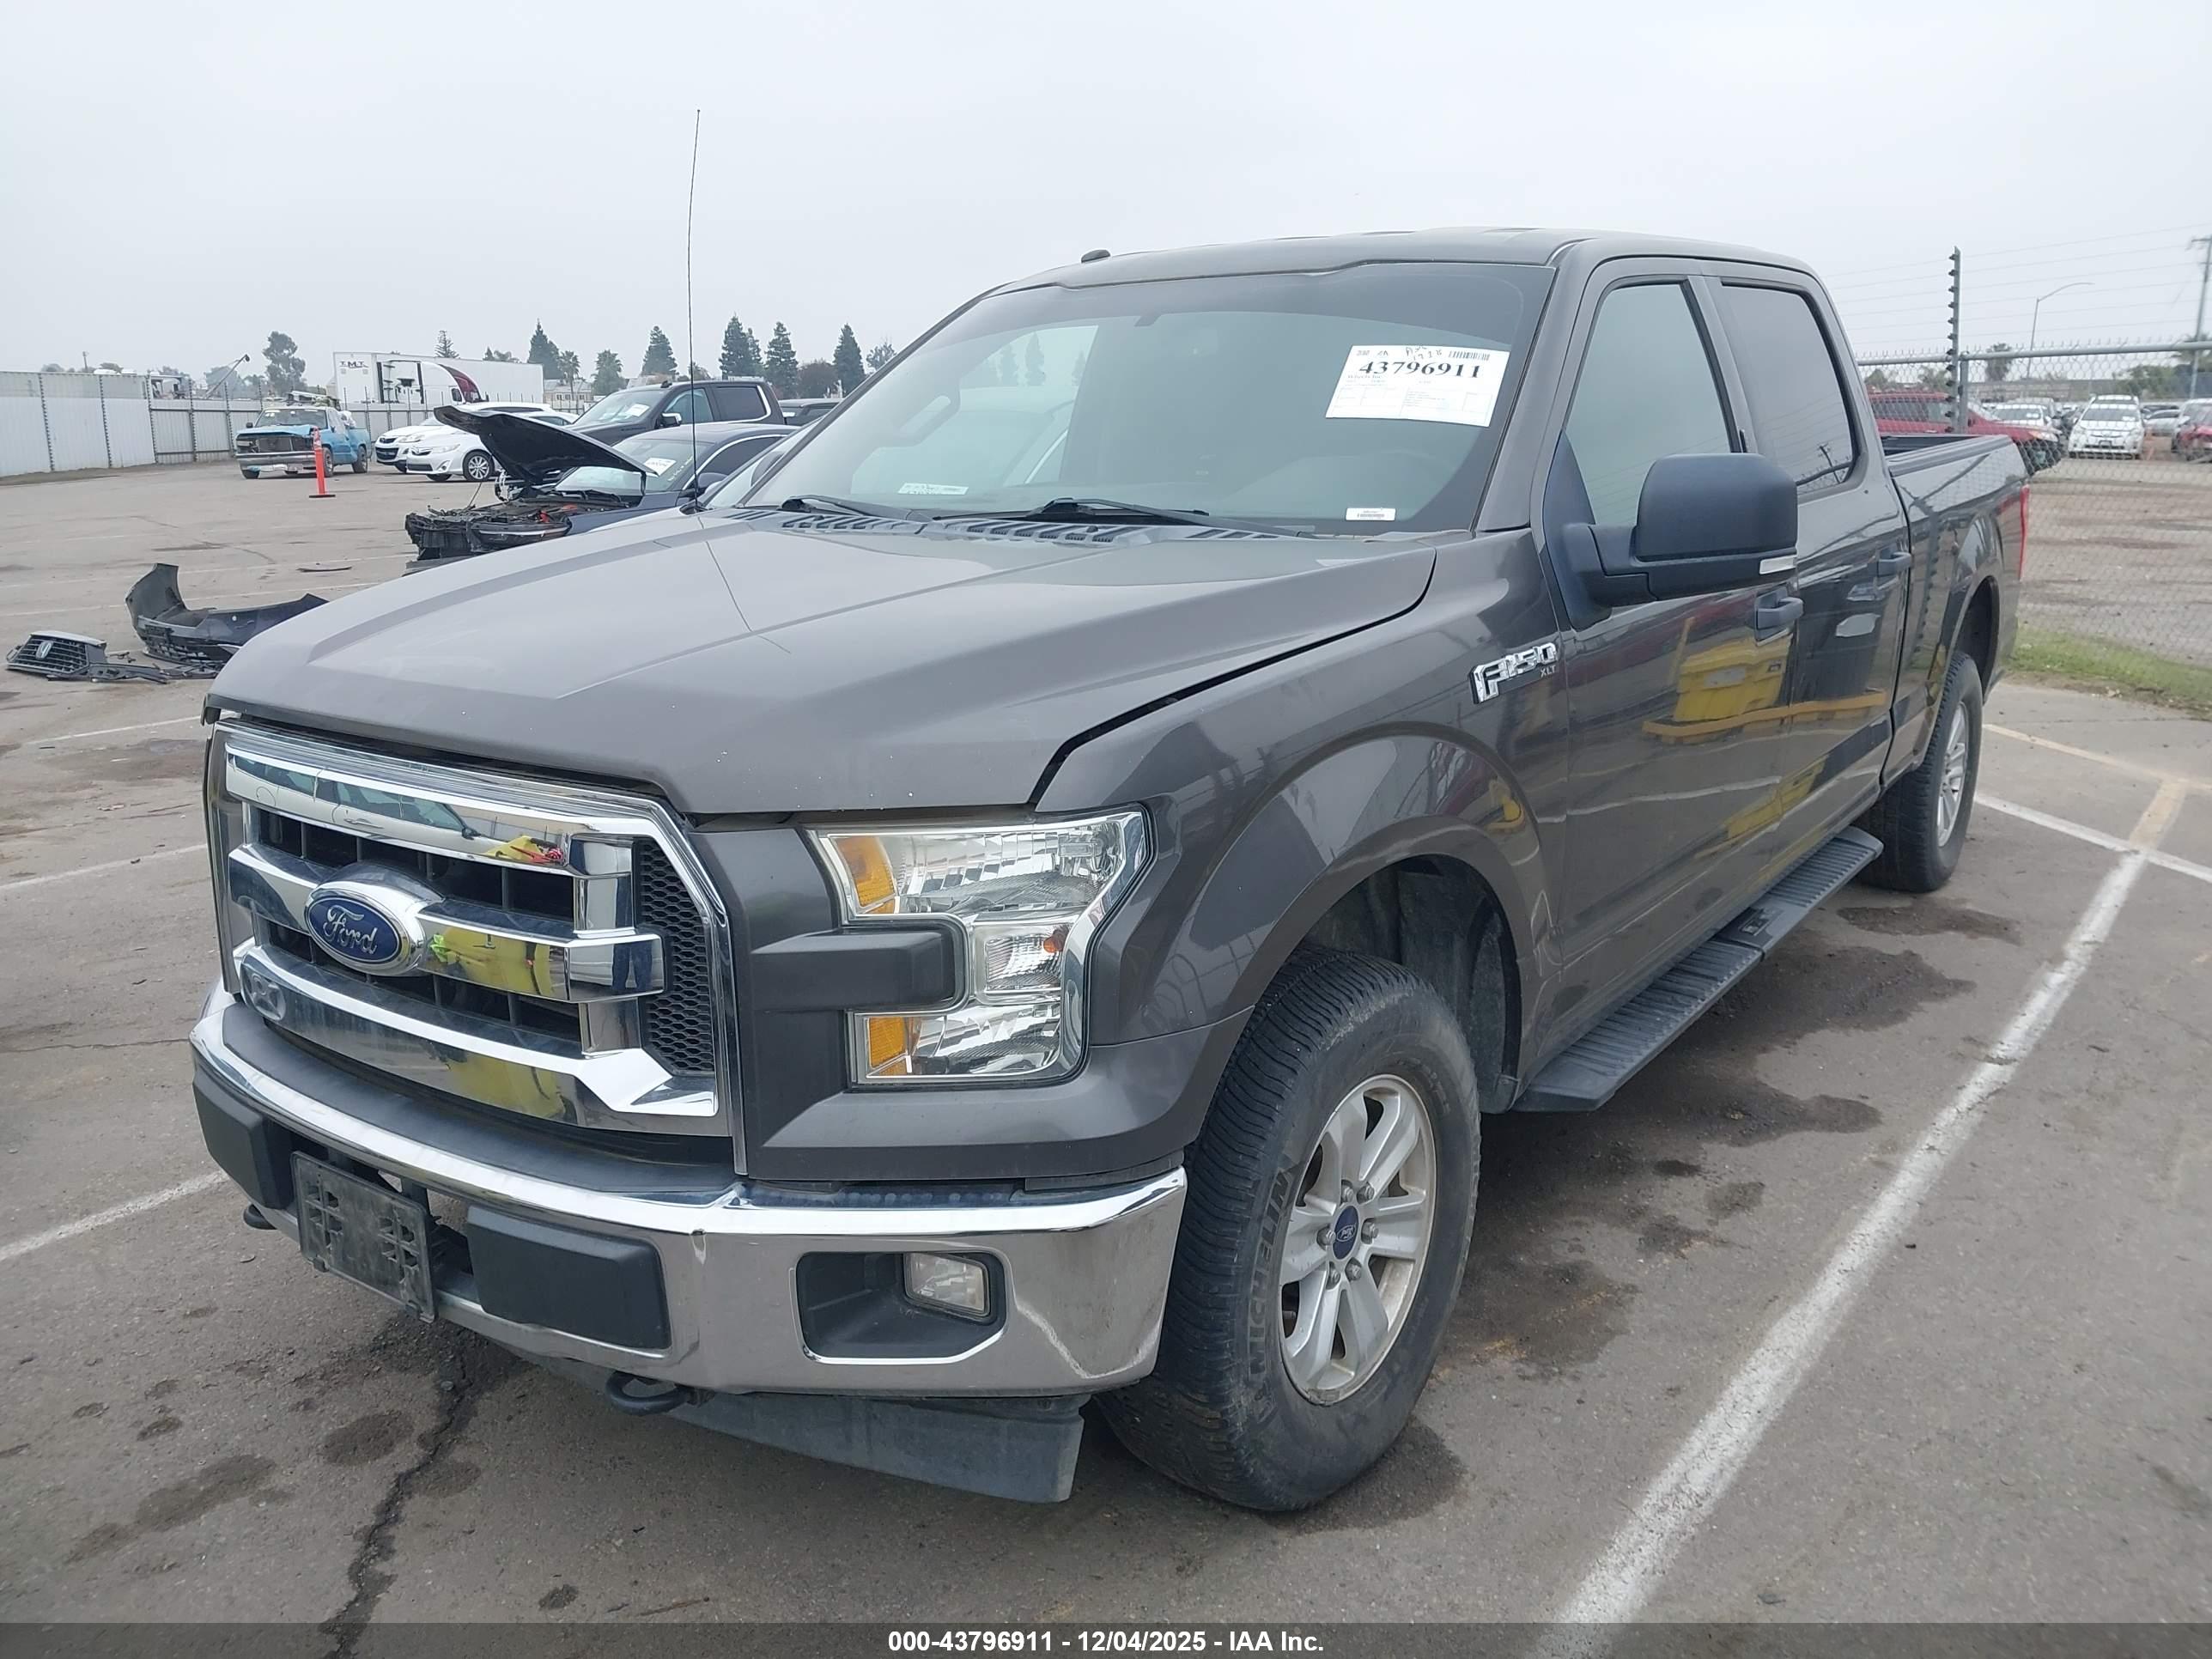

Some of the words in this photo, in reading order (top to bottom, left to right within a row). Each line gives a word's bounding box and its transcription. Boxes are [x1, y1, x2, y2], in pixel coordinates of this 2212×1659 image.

[1358, 361, 1480, 379] 43796911
[1540, 665, 1556, 678] XLT
[323, 904, 378, 954] Ford
[1249, 1168, 1289, 1375] MICHELIN
